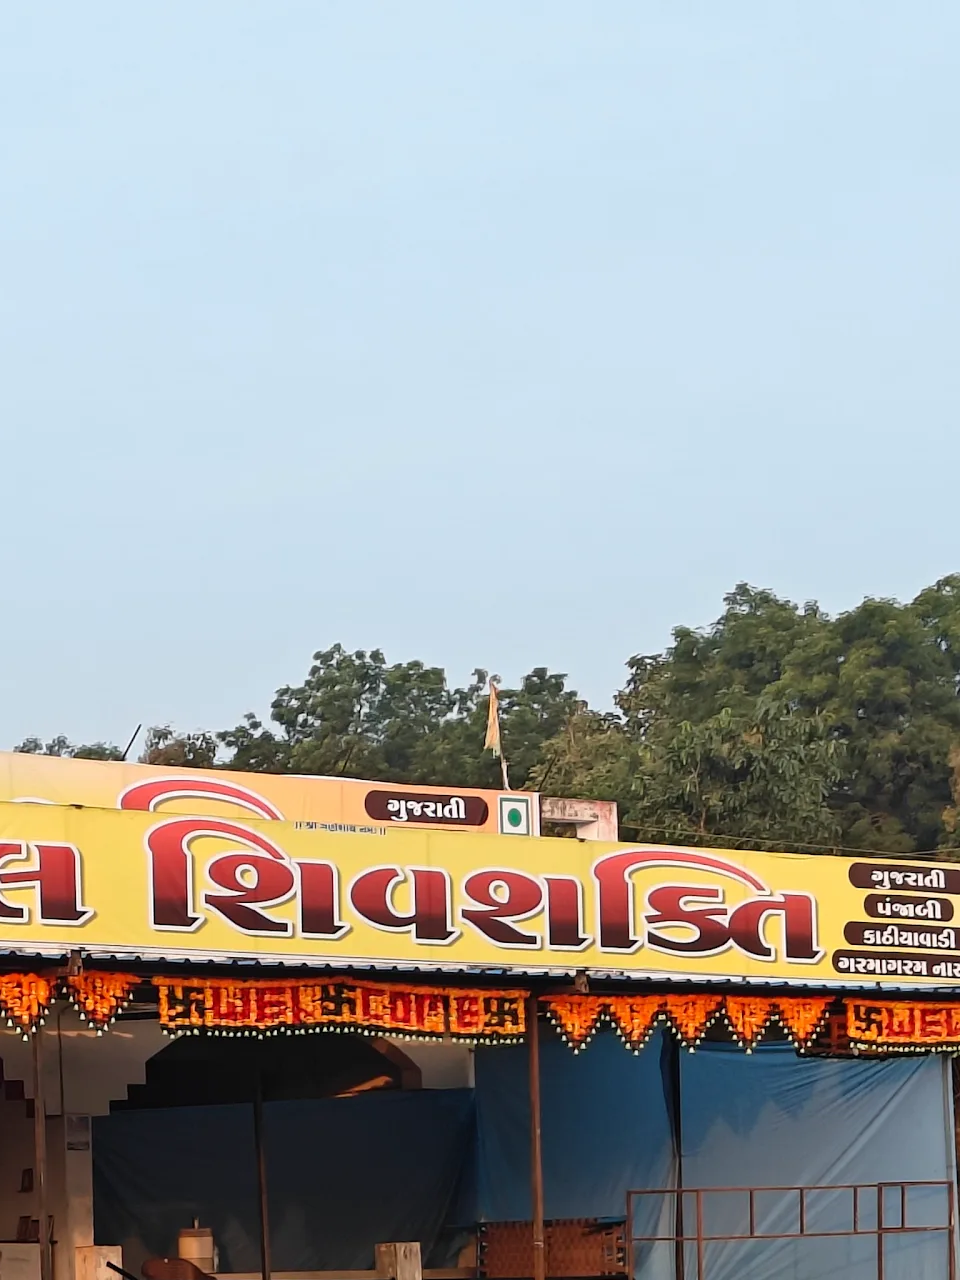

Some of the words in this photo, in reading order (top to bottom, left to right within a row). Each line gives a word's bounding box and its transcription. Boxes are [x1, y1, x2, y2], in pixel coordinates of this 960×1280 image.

[387, 797, 466, 822] ગુજરાતી
[144, 816, 824, 964] શિવશક્તિ
[870, 869, 946, 890] ગુજરાતી
[876, 897, 942, 919] પંજાબી
[863, 925, 956, 949] કાઠીયાવાડી
[837, 956, 928, 976] ગરમાગરમ
